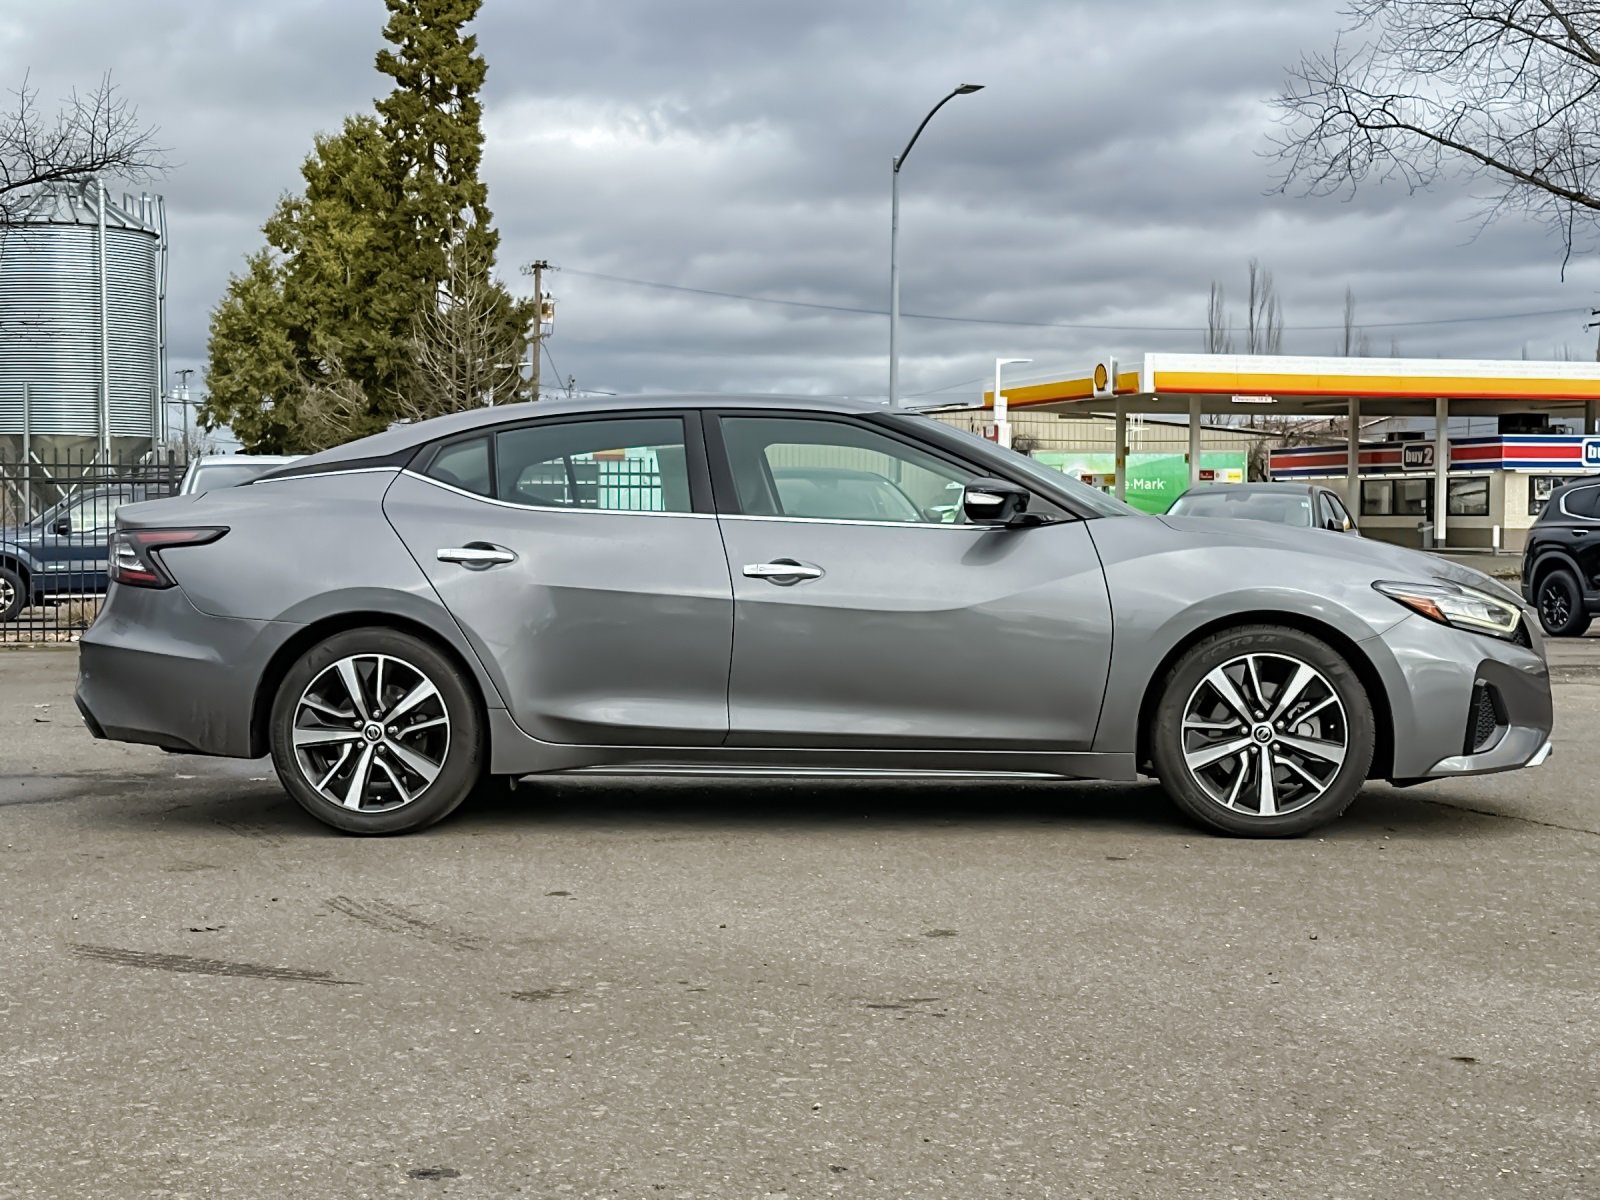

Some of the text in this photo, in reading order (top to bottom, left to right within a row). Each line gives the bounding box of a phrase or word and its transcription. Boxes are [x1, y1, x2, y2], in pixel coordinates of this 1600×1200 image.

[1405, 447, 1433, 464] buy 2
[1124, 477, 1165, 490] e-Mark
